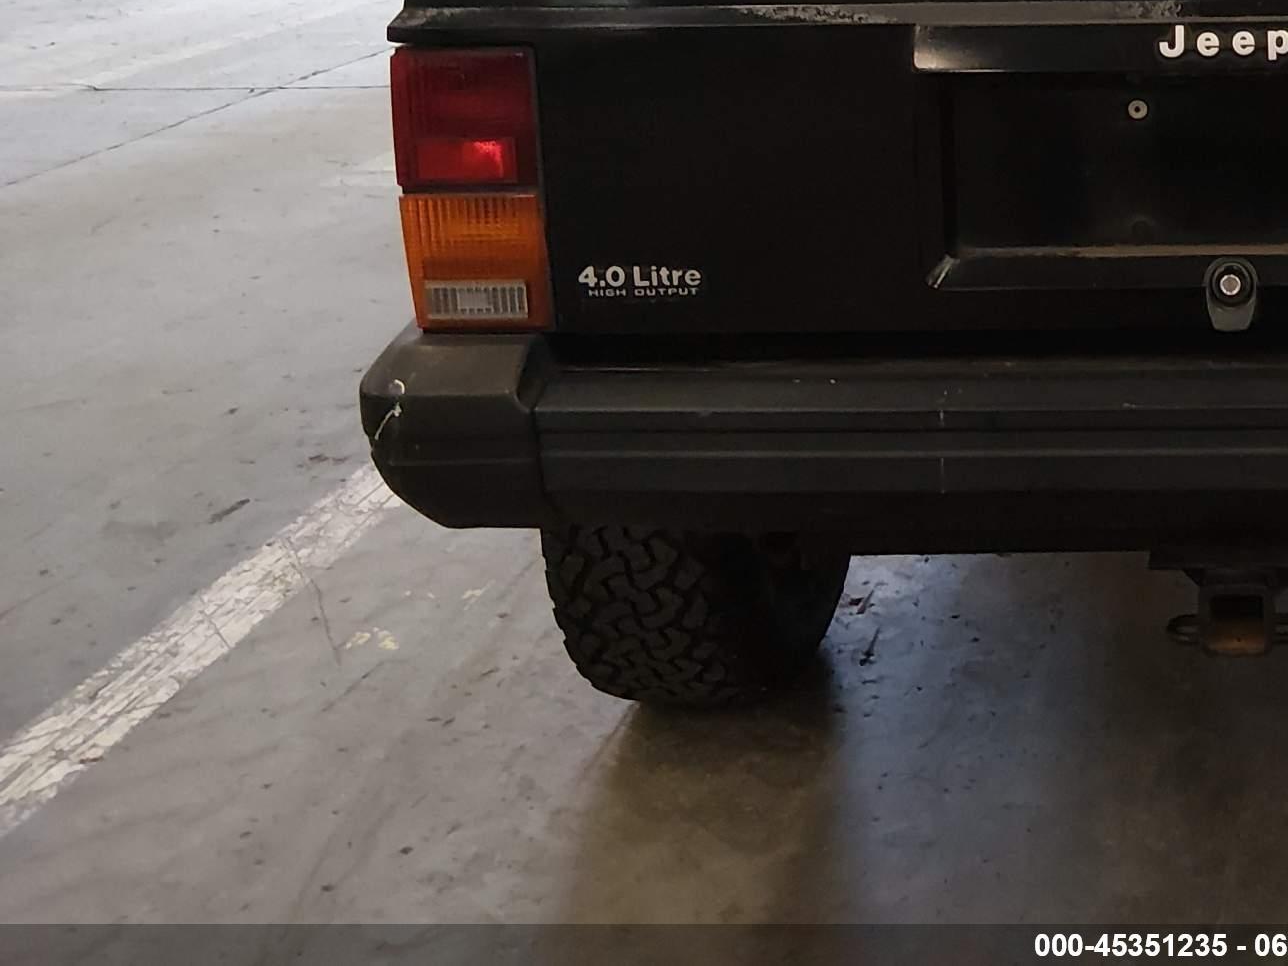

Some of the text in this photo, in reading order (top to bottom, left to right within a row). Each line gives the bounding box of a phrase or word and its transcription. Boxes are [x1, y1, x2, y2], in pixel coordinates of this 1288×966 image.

[578, 265, 701, 287] 4.0 Litre
[588, 287, 699, 297] HIGH OUTPUT
